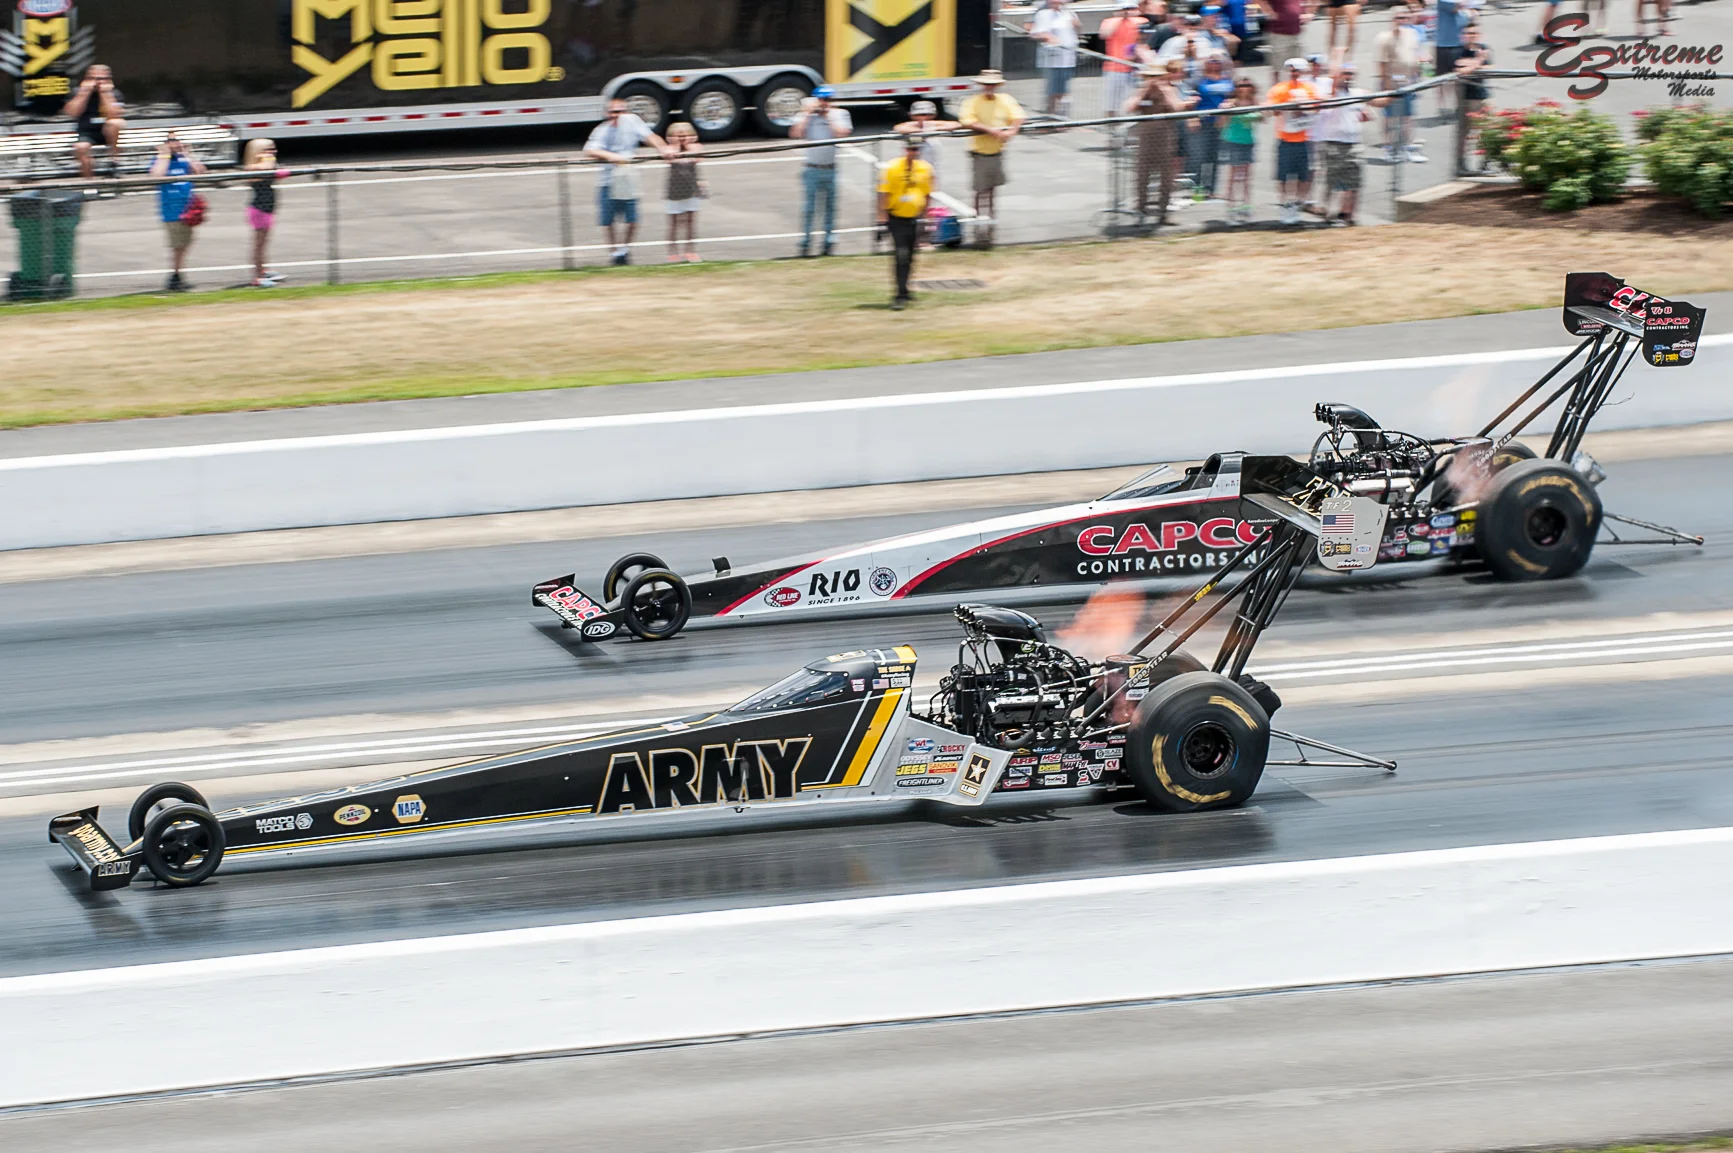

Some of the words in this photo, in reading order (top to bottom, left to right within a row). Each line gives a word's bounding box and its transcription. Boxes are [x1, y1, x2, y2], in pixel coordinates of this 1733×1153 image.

[1646, 317, 1690, 326] CAPCO
[1341, 500, 1352, 512] 2
[1077, 552, 1228, 575] CONTRACTORS
[809, 569, 860, 597] RIO
[1010, 757, 1037, 765] ARP
[896, 764, 927, 776] JEGS
[596, 737, 814, 817] ARMY
[898, 778, 943, 787] FREIGHTLINER
[397, 801, 422, 816] NAPA
[255, 815, 294, 827] MATCO
[339, 809, 367, 821] PENNZOIL
[256, 822, 295, 834] TOOLS
[98, 861, 131, 876] ARMY
